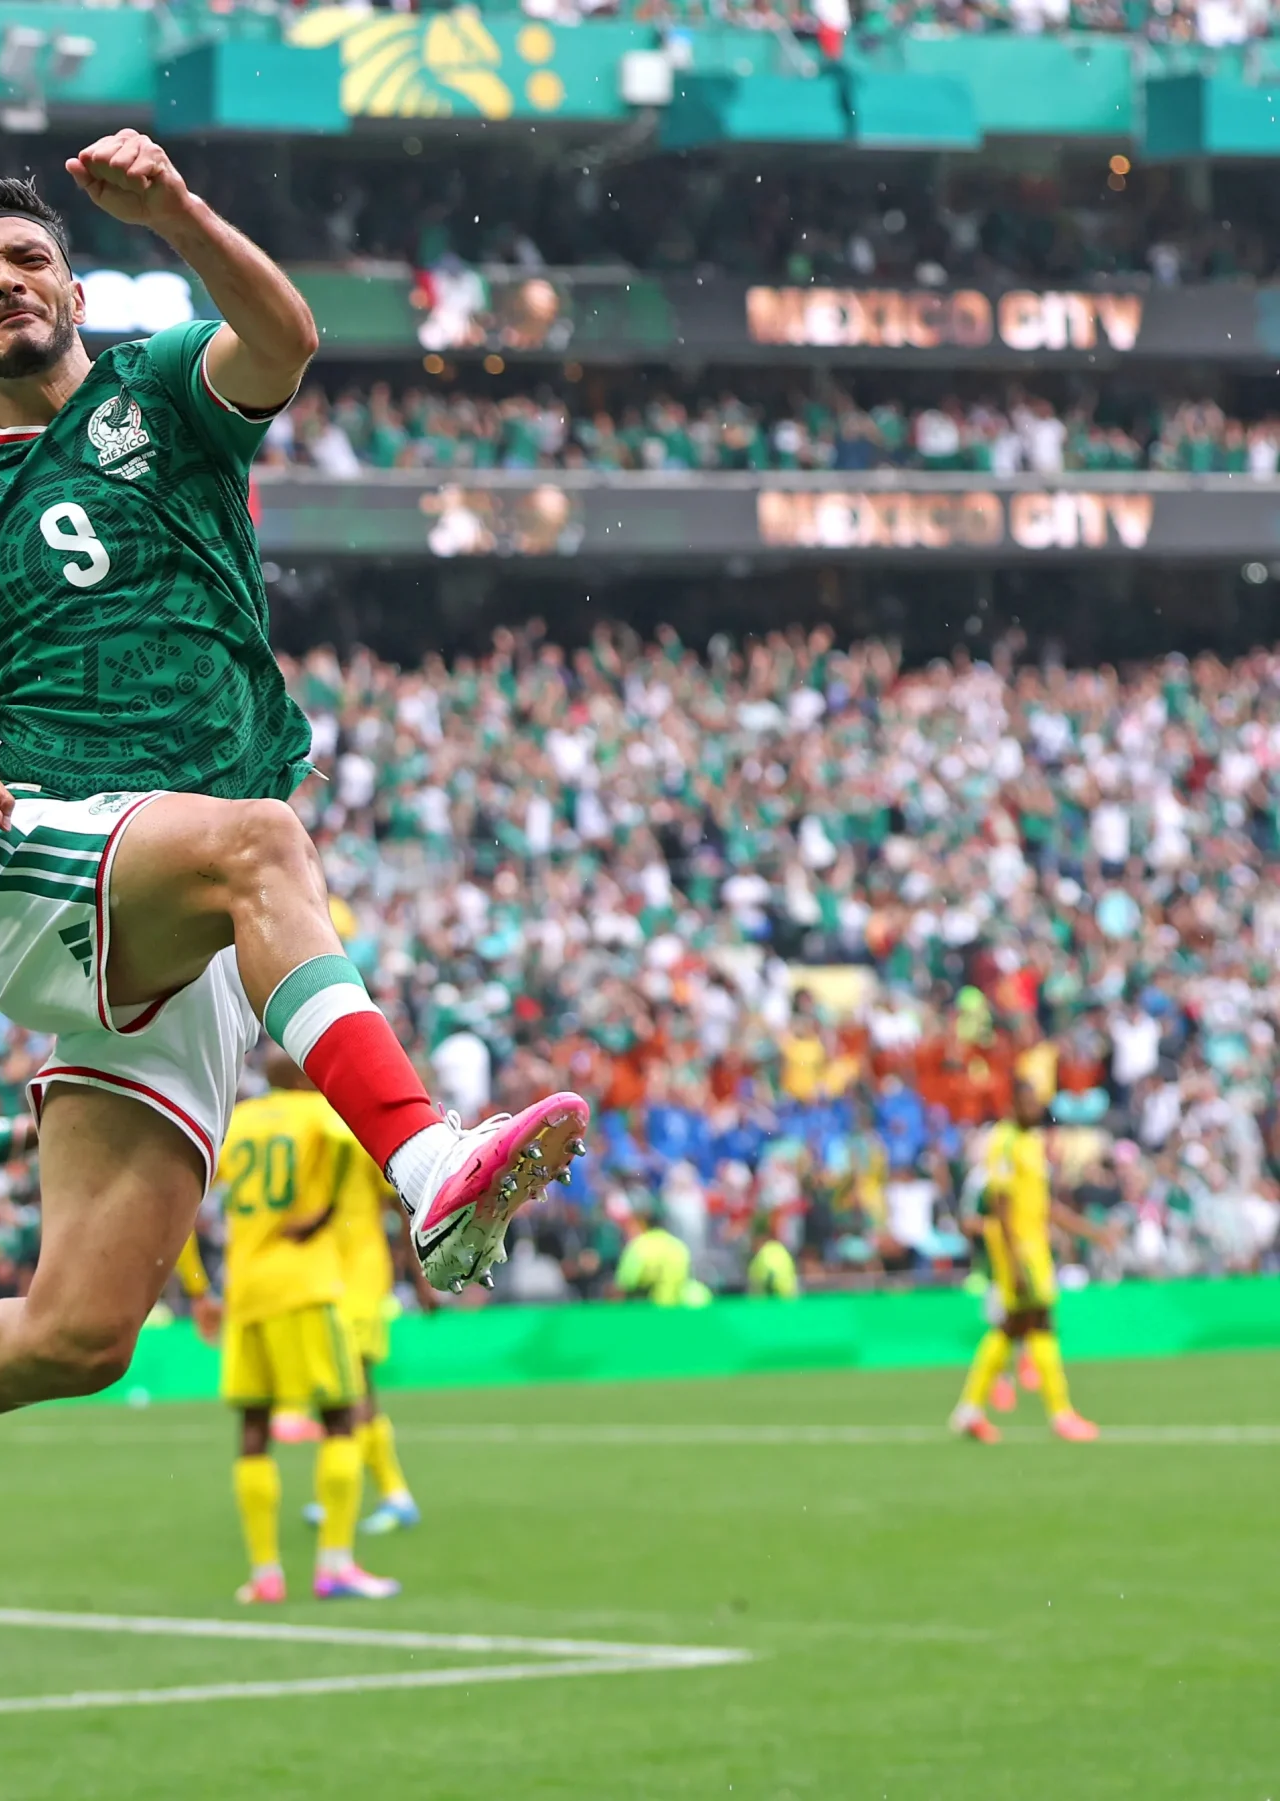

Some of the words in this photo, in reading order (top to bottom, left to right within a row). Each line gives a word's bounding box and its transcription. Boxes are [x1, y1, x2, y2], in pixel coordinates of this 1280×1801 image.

[745, 286, 992, 348] MEXICO
[999, 290, 1143, 350] CITY
[100, 434, 147, 464] MÉXICO
[40, 501, 110, 588] 9
[757, 490, 1004, 548] MEXICO
[1010, 491, 1154, 549] CITY
[225, 1133, 297, 1215] 20
